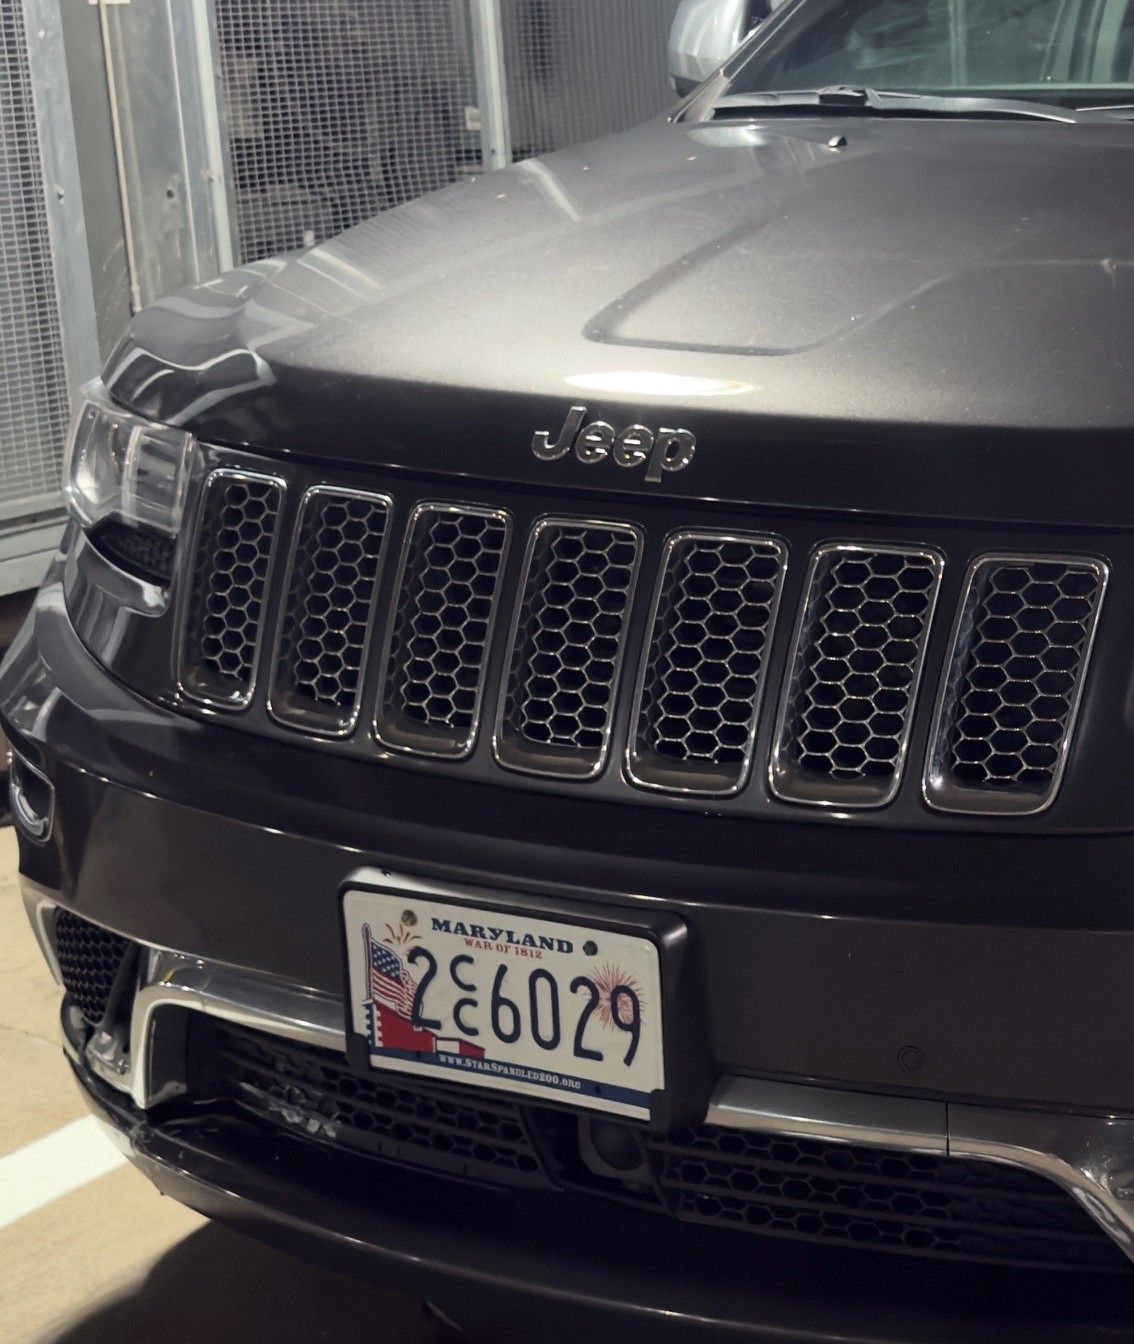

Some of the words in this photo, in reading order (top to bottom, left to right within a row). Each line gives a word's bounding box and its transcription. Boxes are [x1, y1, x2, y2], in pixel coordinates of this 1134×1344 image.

[531, 406, 697, 483] Jeep
[431, 917, 574, 954] MARYLAND
[464, 937, 492, 951] WAR
[496, 943, 511, 954] OF
[515, 947, 542, 959] 1812
